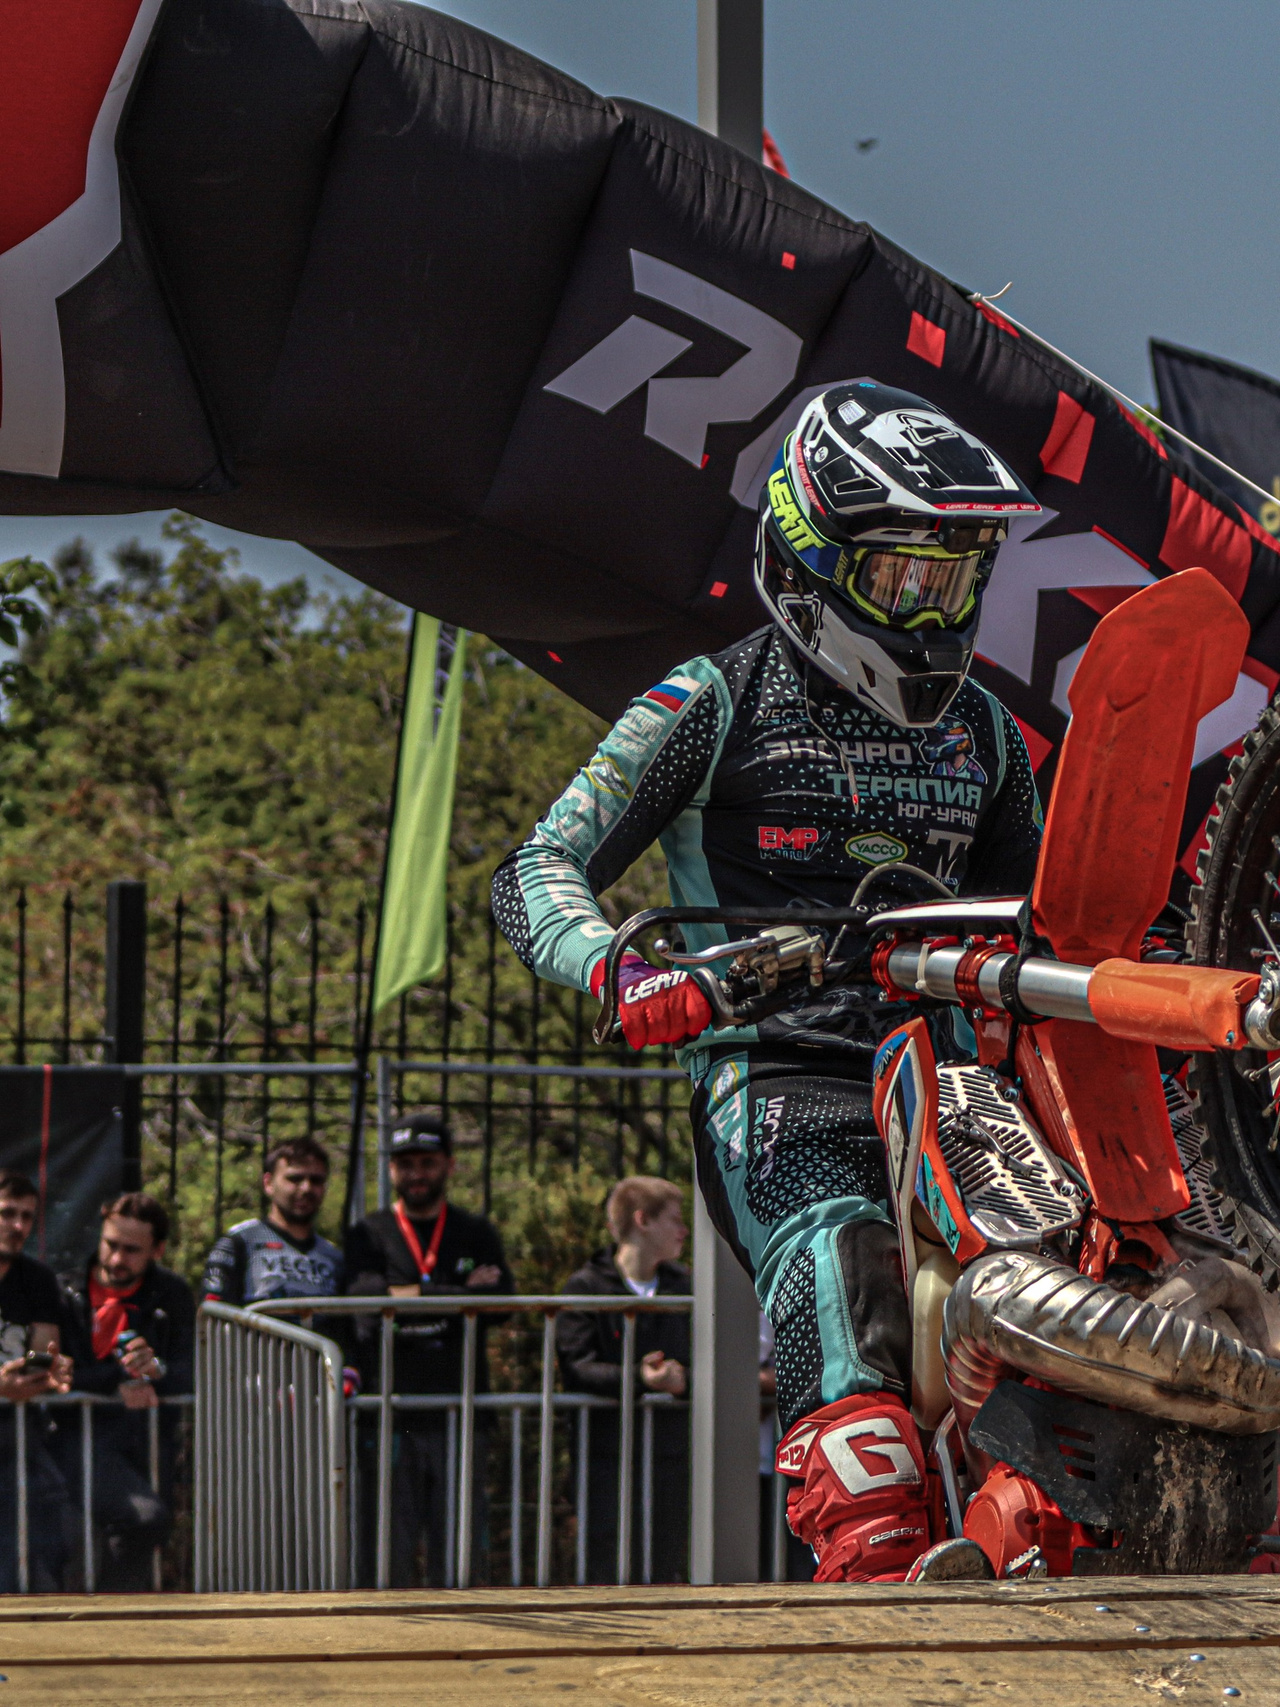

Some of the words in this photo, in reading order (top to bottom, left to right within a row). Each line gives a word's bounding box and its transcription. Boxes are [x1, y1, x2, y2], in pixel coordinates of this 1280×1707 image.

[768, 468, 827, 552] LEATT
[762, 708, 835, 719] VECTR
[826, 773, 983, 810] ТЕРАПИЯ
[758, 826, 819, 850] EMP
[855, 842, 898, 856] YACCO
